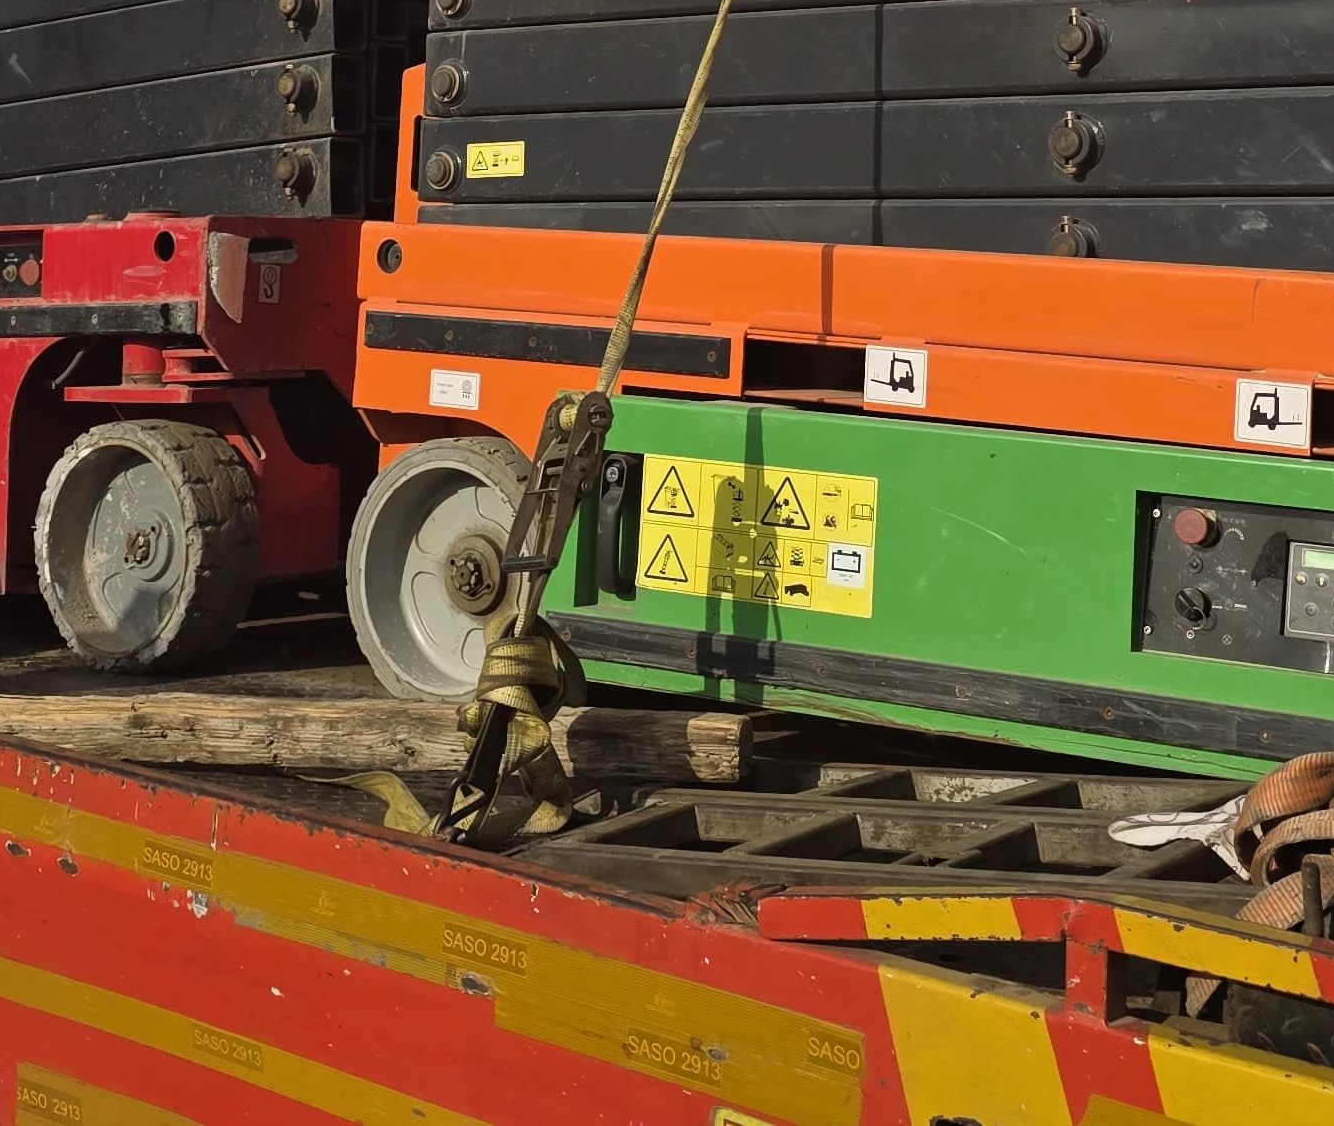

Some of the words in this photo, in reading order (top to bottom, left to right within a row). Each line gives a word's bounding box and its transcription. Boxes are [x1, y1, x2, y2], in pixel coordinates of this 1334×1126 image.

[143, 847, 180, 871] SASO
[182, 859, 213, 881] 2913
[443, 929, 487, 956] SASO
[490, 943, 527, 969] 2913
[194, 1029, 229, 1055] SASO
[232, 1043, 261, 1066] 2913
[627, 1035, 676, 1066] SASO
[681, 1051, 722, 1082] 2913
[808, 1037, 860, 1070] SASO
[53, 1098, 81, 1122] 2913
